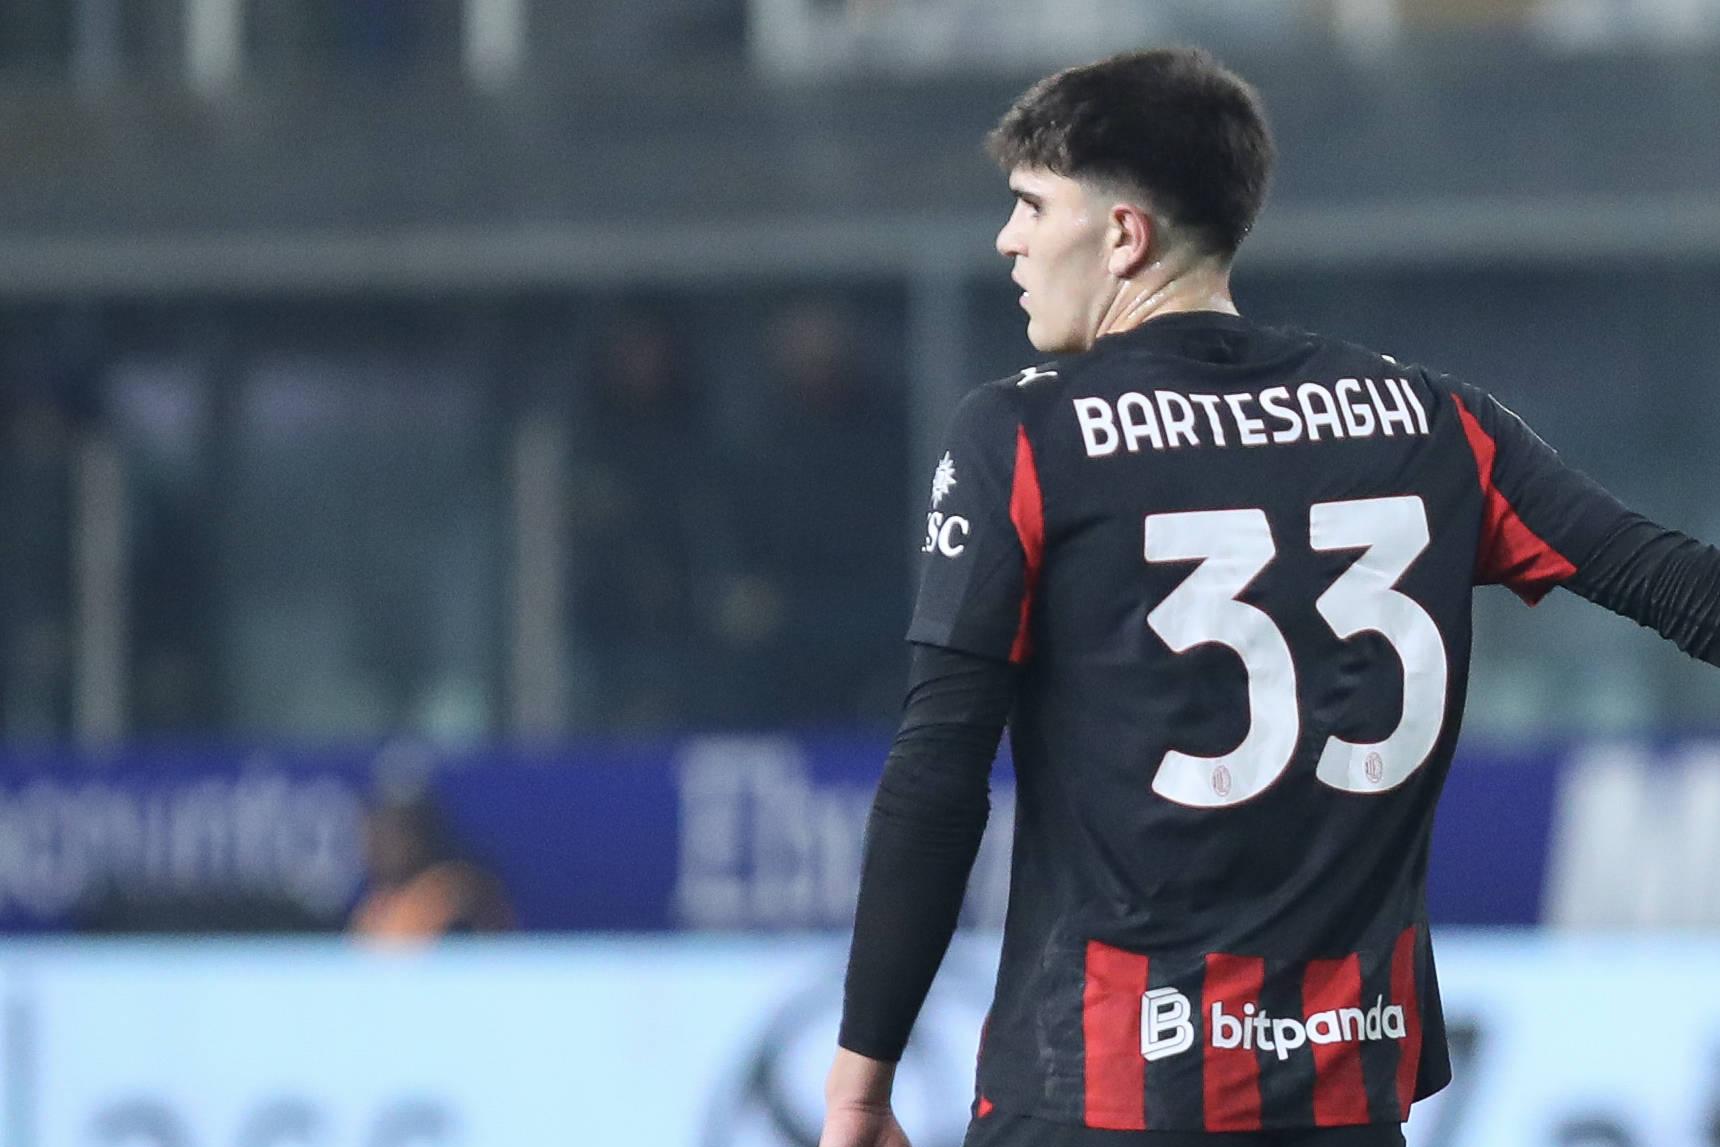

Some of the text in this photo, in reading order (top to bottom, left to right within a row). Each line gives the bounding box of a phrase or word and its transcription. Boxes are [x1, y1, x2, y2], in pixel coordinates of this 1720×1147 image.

[1073, 377, 1430, 458] BARTESAGHI
[921, 510, 970, 558] SC
[1143, 495, 1448, 808] 33
[1210, 993, 1407, 1061] bitpanda
